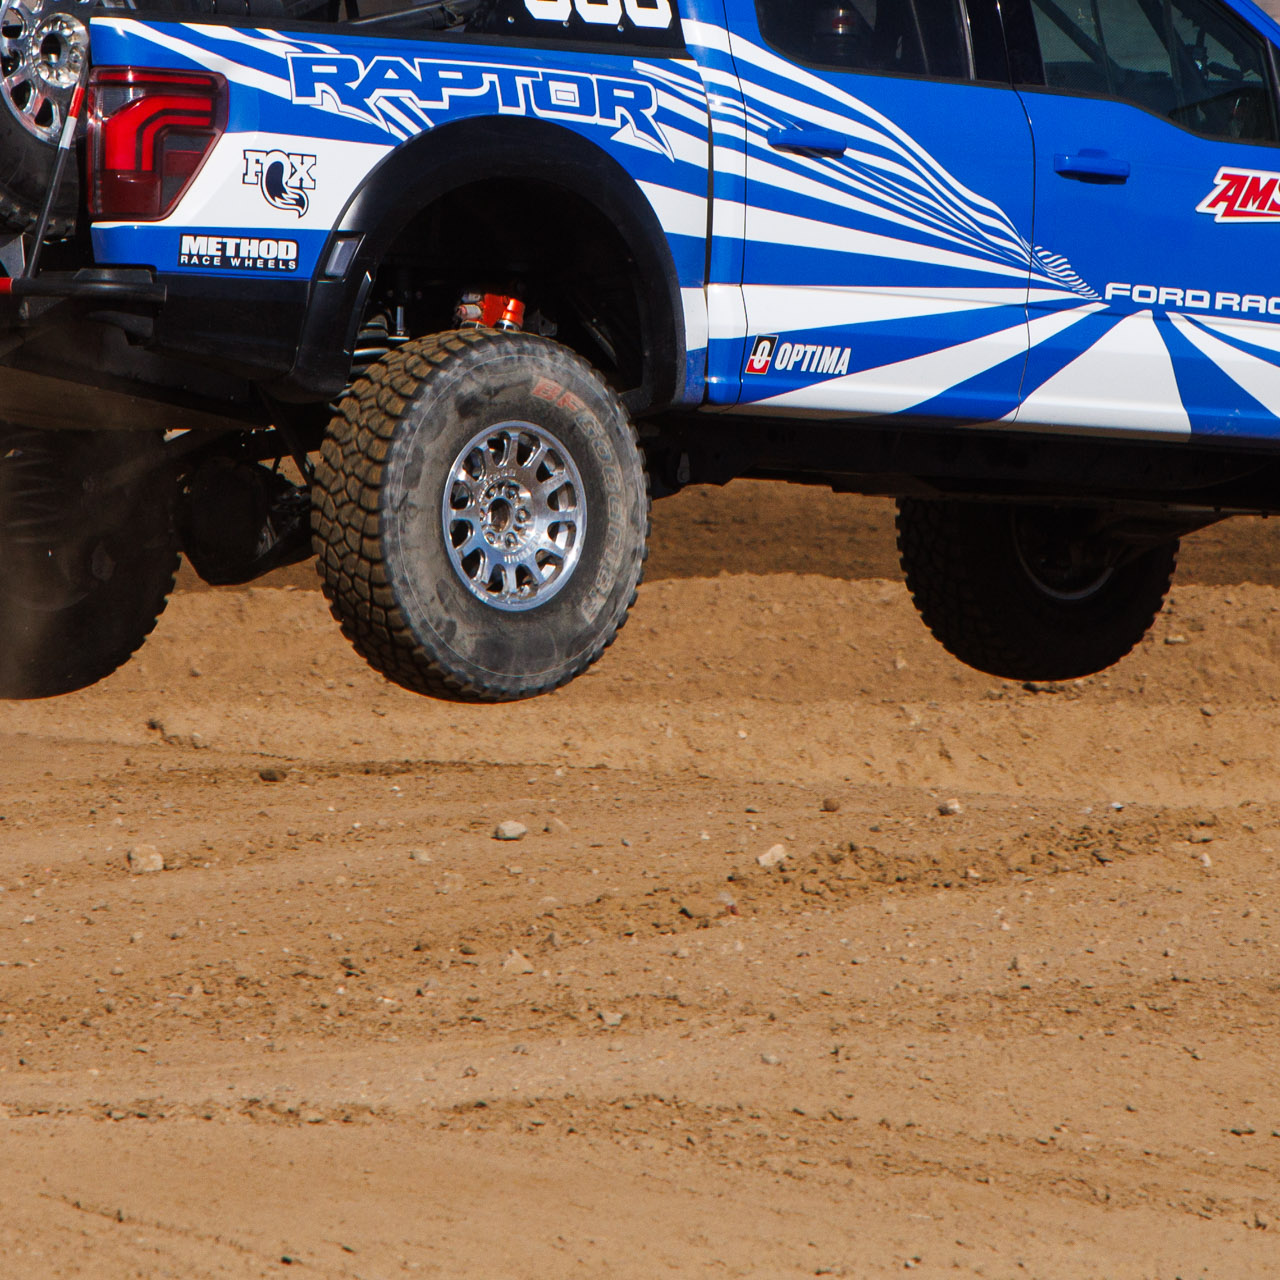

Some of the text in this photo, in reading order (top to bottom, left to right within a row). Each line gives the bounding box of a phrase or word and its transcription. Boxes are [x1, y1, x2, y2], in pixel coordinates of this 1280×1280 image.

[286, 52, 675, 162] RAPTOR
[242, 149, 317, 218] FOX
[180, 255, 296, 269] RACE WHEELS
[181, 235, 297, 260] METHOD
[1105, 282, 1210, 308] FORD
[774, 342, 852, 375] OPTIMA
